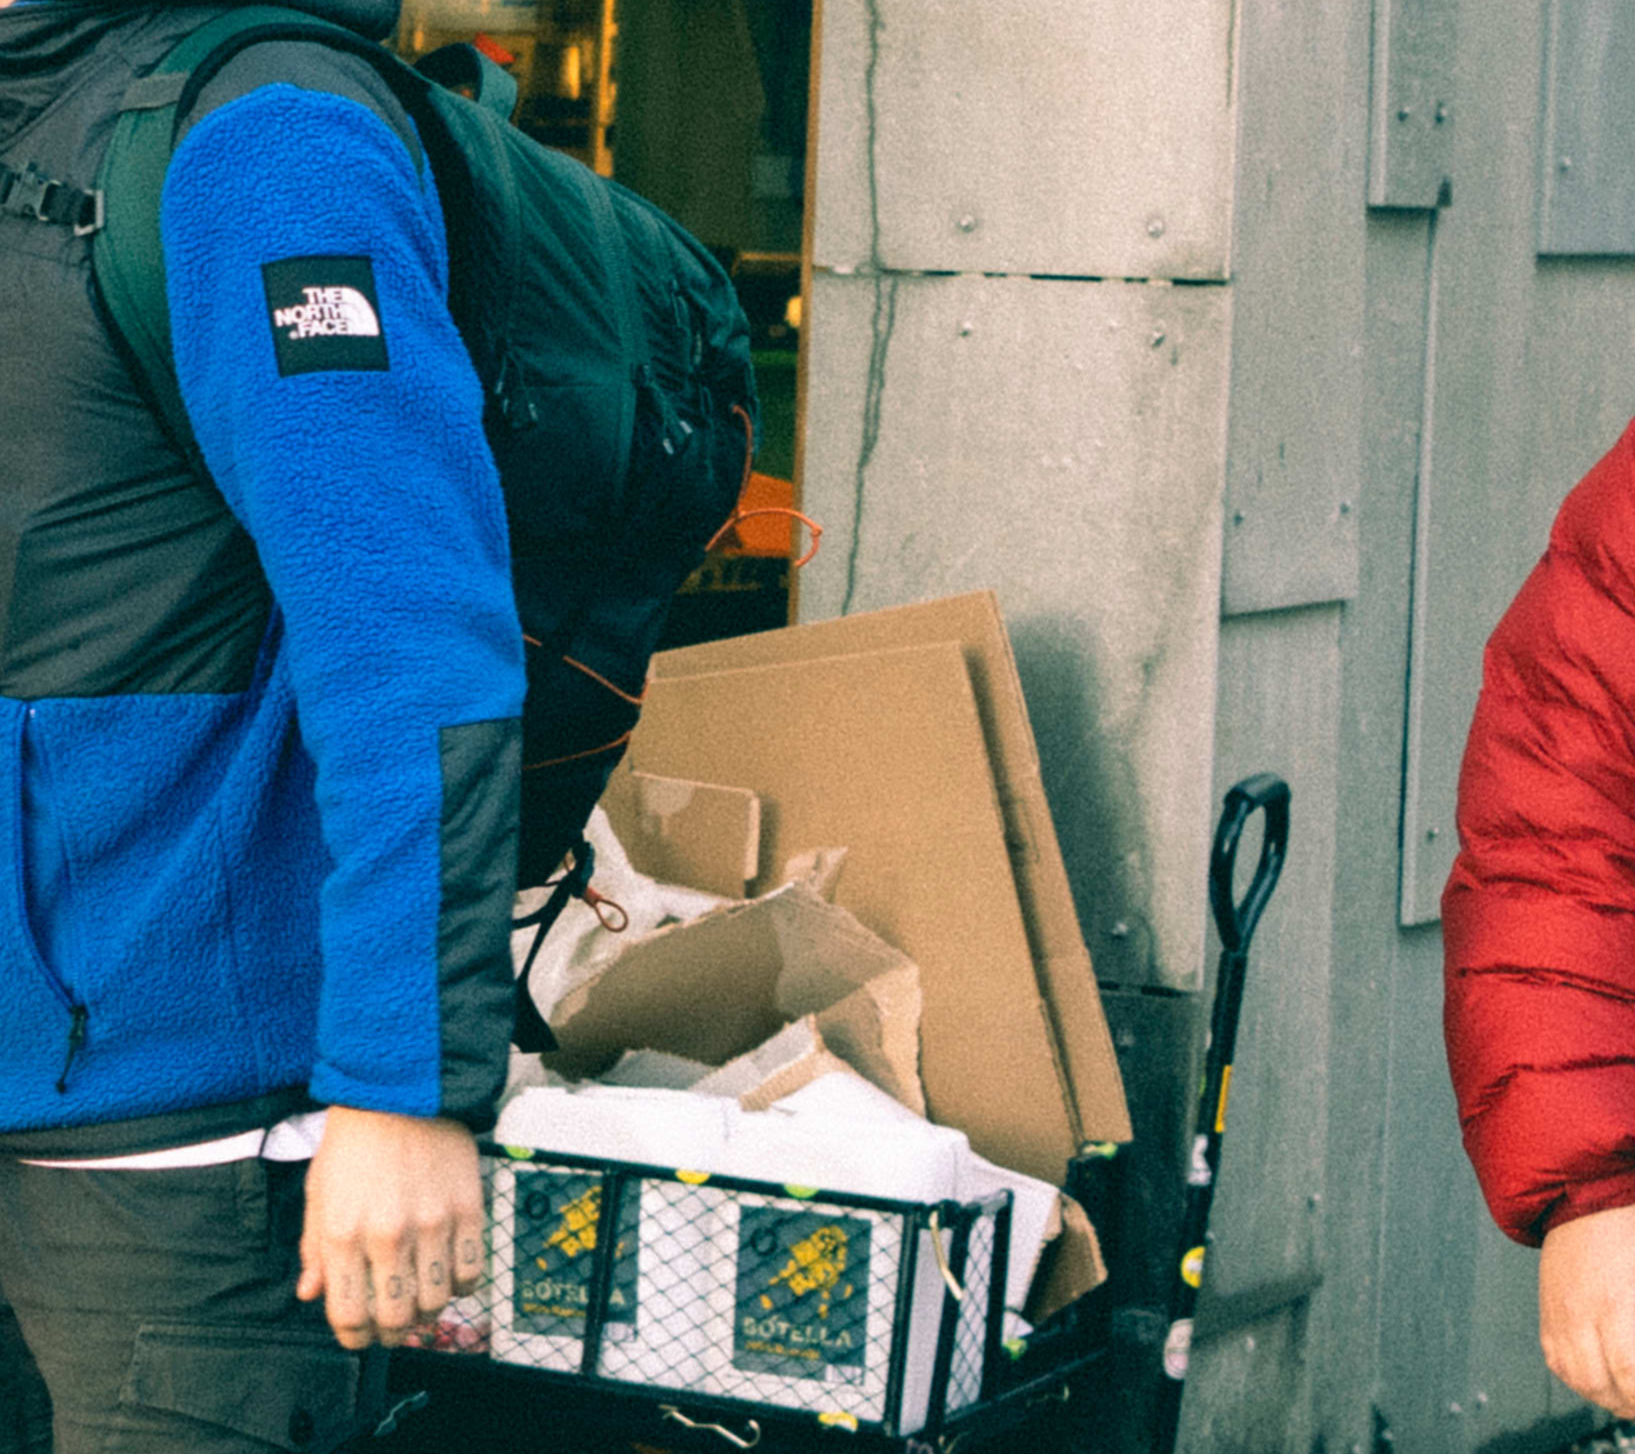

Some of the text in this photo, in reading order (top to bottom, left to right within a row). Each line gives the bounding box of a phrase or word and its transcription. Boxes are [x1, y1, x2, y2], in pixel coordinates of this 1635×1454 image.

[302, 287, 343, 304] THE
[274, 304, 343, 327] NORTH
[298, 320, 348, 338] FACE
